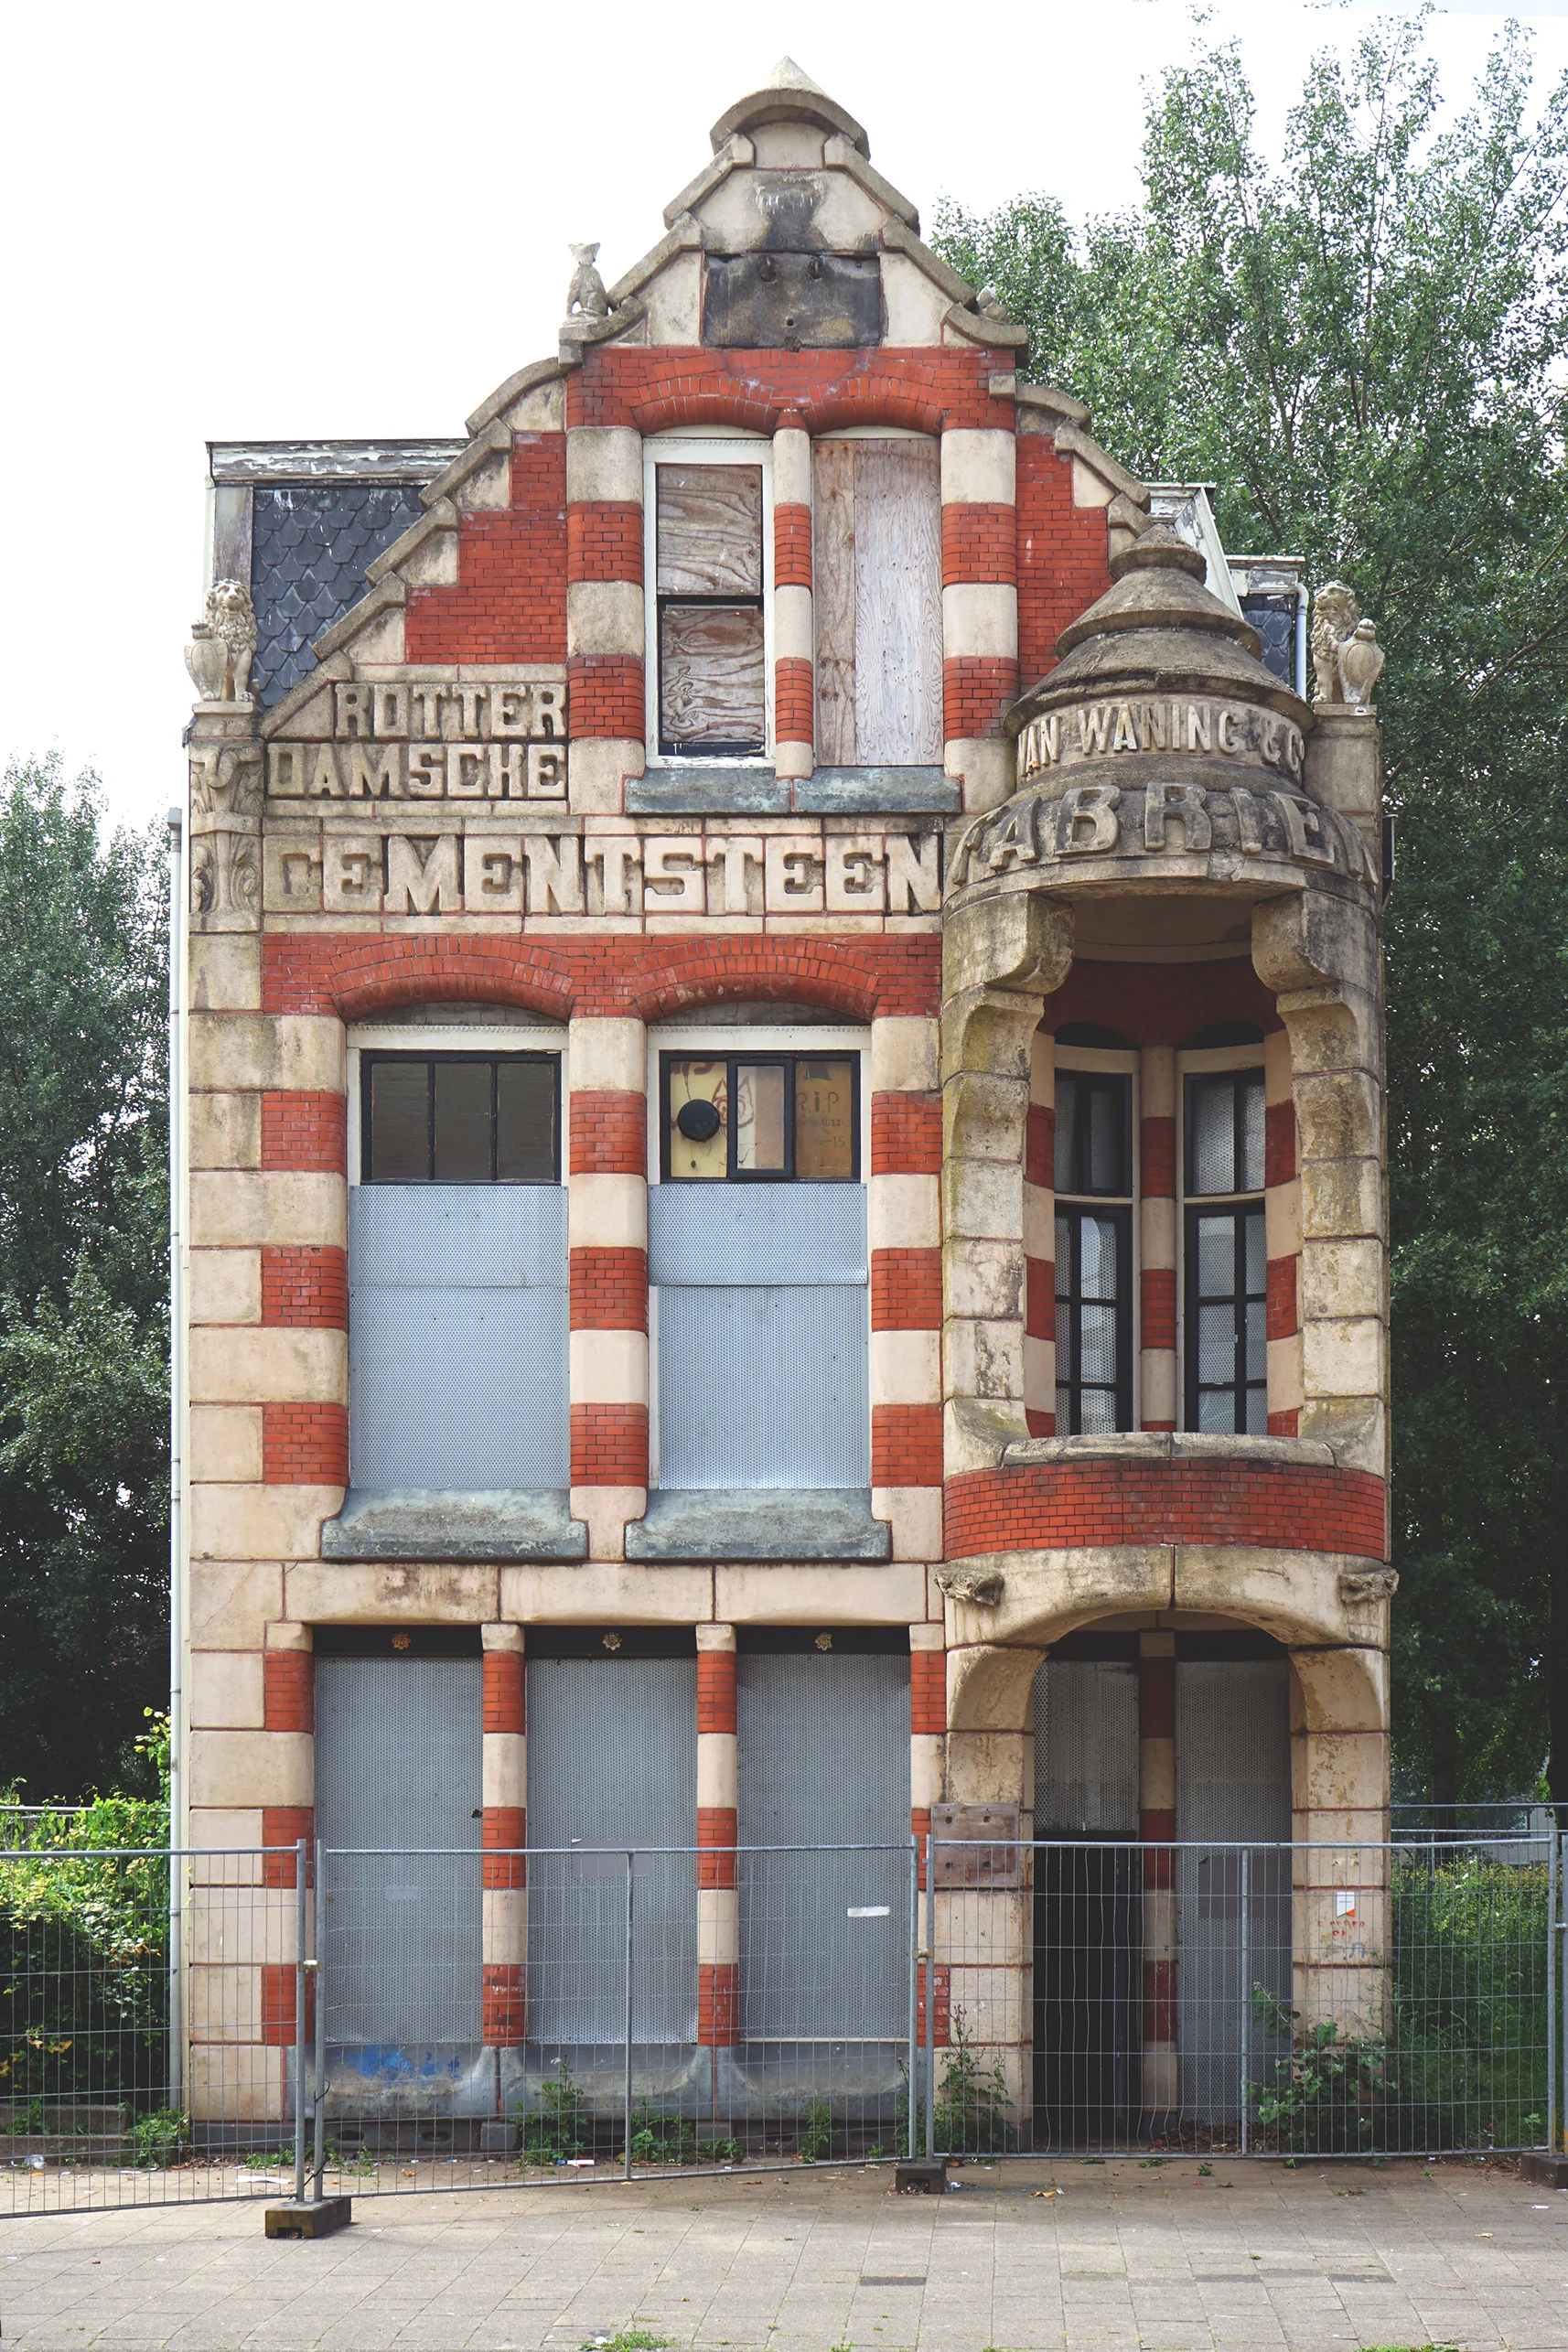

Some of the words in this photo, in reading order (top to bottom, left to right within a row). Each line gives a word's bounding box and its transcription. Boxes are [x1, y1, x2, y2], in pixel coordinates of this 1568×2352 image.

[334, 682, 567, 739] ROTTER
[1017, 715, 1061, 778] VAN
[1078, 703, 1242, 756] WANING
[267, 742, 566, 798] DAMSCHE
[952, 782, 1380, 886] FABRIEK
[263, 834, 942, 916] CEMENTSTEEN
